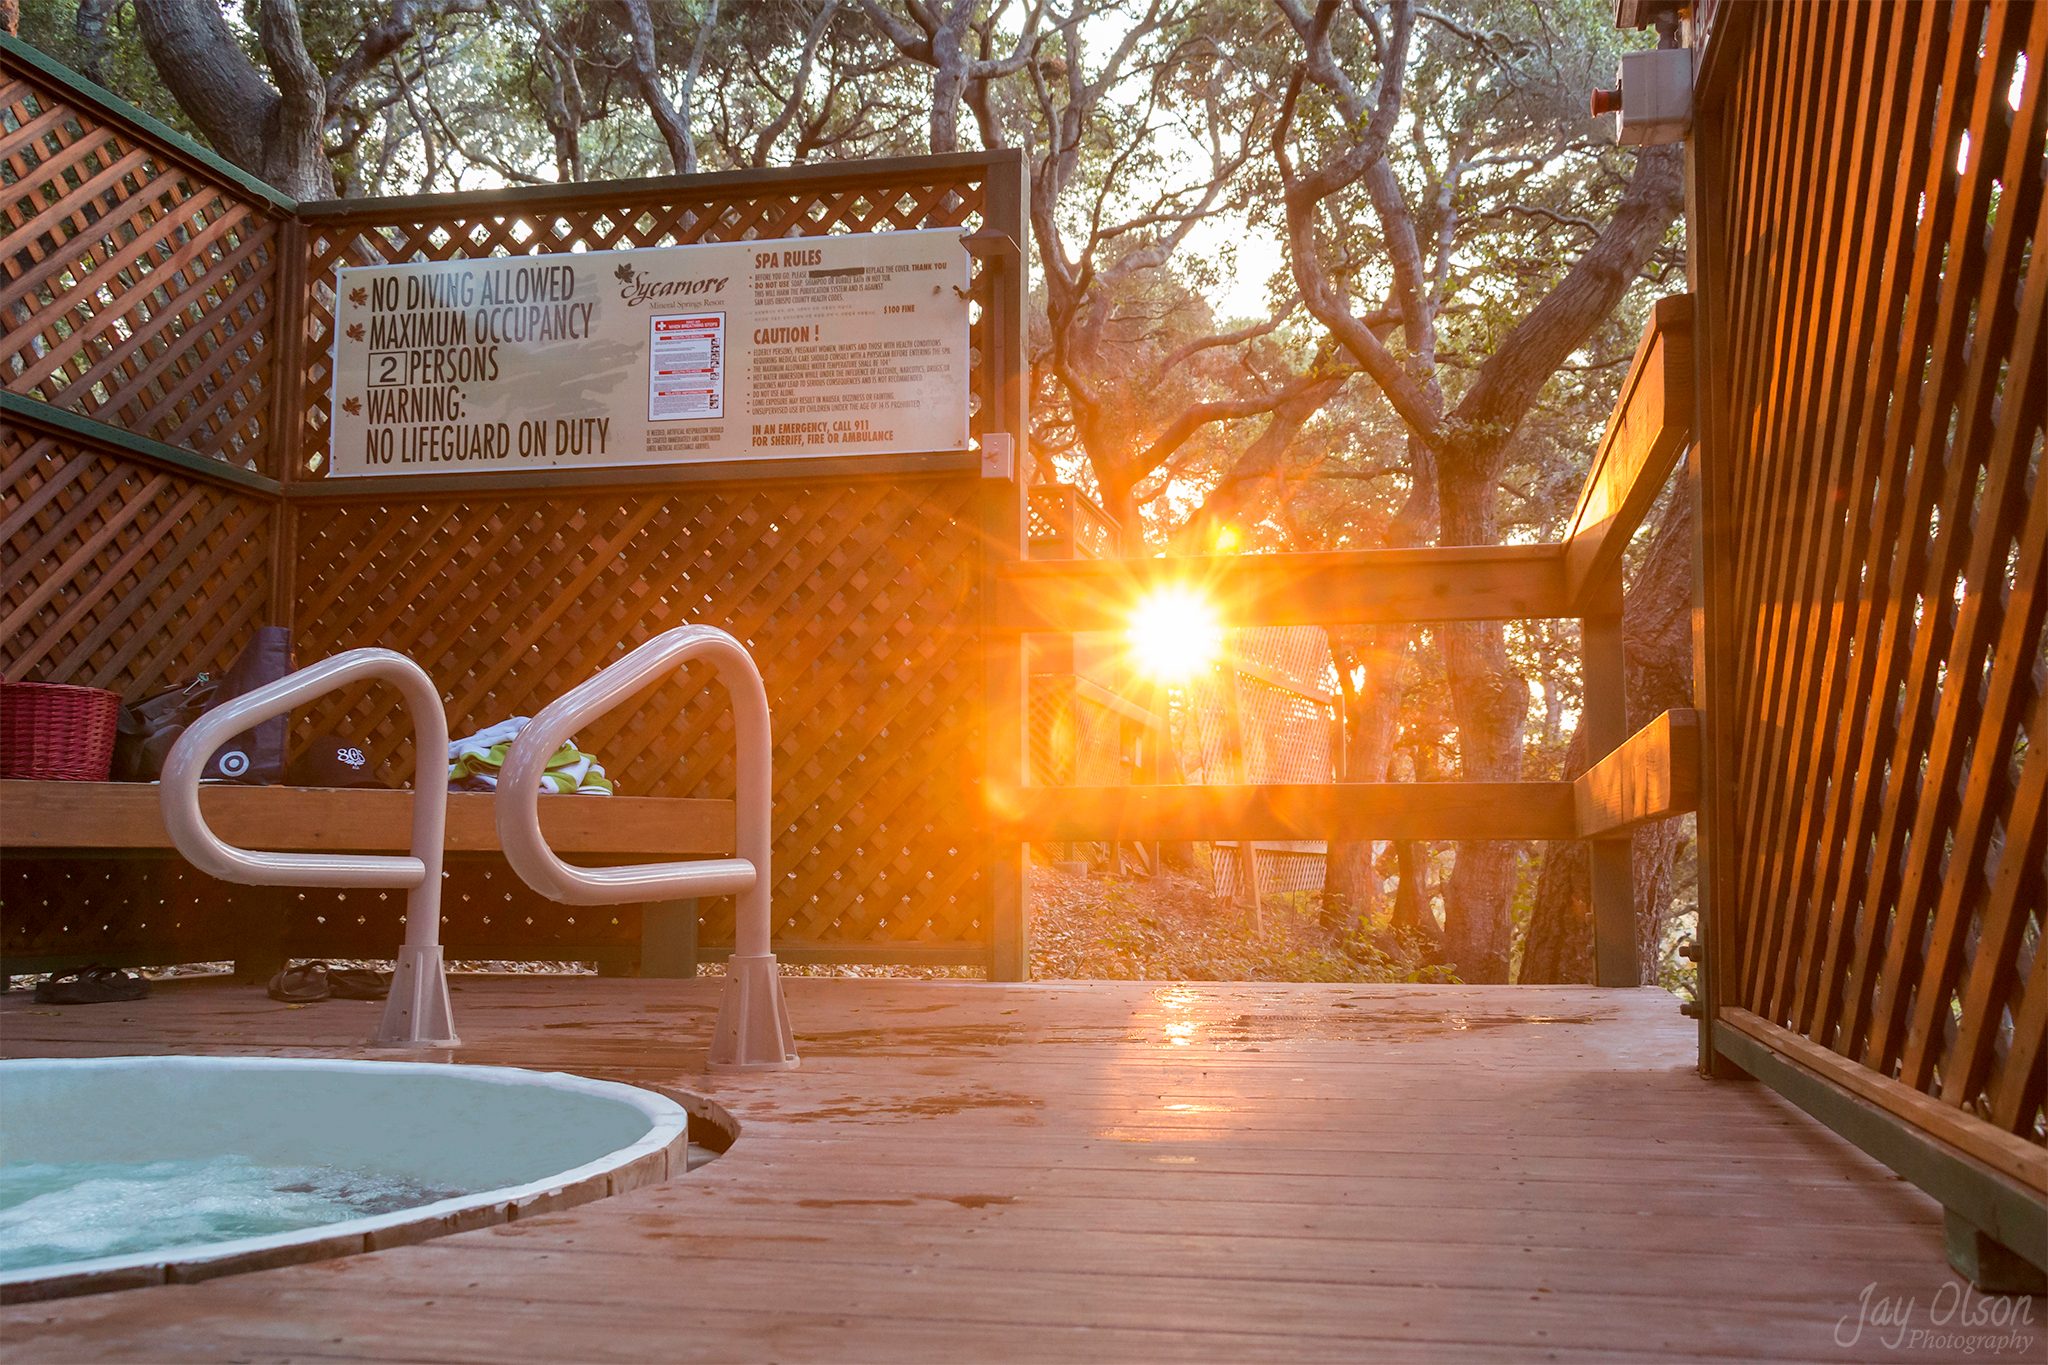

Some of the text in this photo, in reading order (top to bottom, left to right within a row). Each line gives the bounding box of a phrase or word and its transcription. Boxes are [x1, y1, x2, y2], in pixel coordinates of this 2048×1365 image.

[755, 249, 822, 268] SPA RULES
[372, 265, 575, 312] NO DIVING ALLOWED
[621, 271, 729, 307] Sycamore
[369, 302, 593, 350] MAXIMUM OCCUPANCY
[884, 305, 914, 314] $100 FINE
[754, 324, 819, 345] CAUTION !
[379, 346, 499, 385] 2 PERSONS
[367, 385, 466, 425] WARNING:
[366, 417, 610, 465] NO LIFEGUARD ON DUTY
[752, 420, 868, 435] IN AN EMERGENCY, CALL 911
[752, 431, 894, 446] FOR SHERIFF, FIRE OR AMBULANCE
